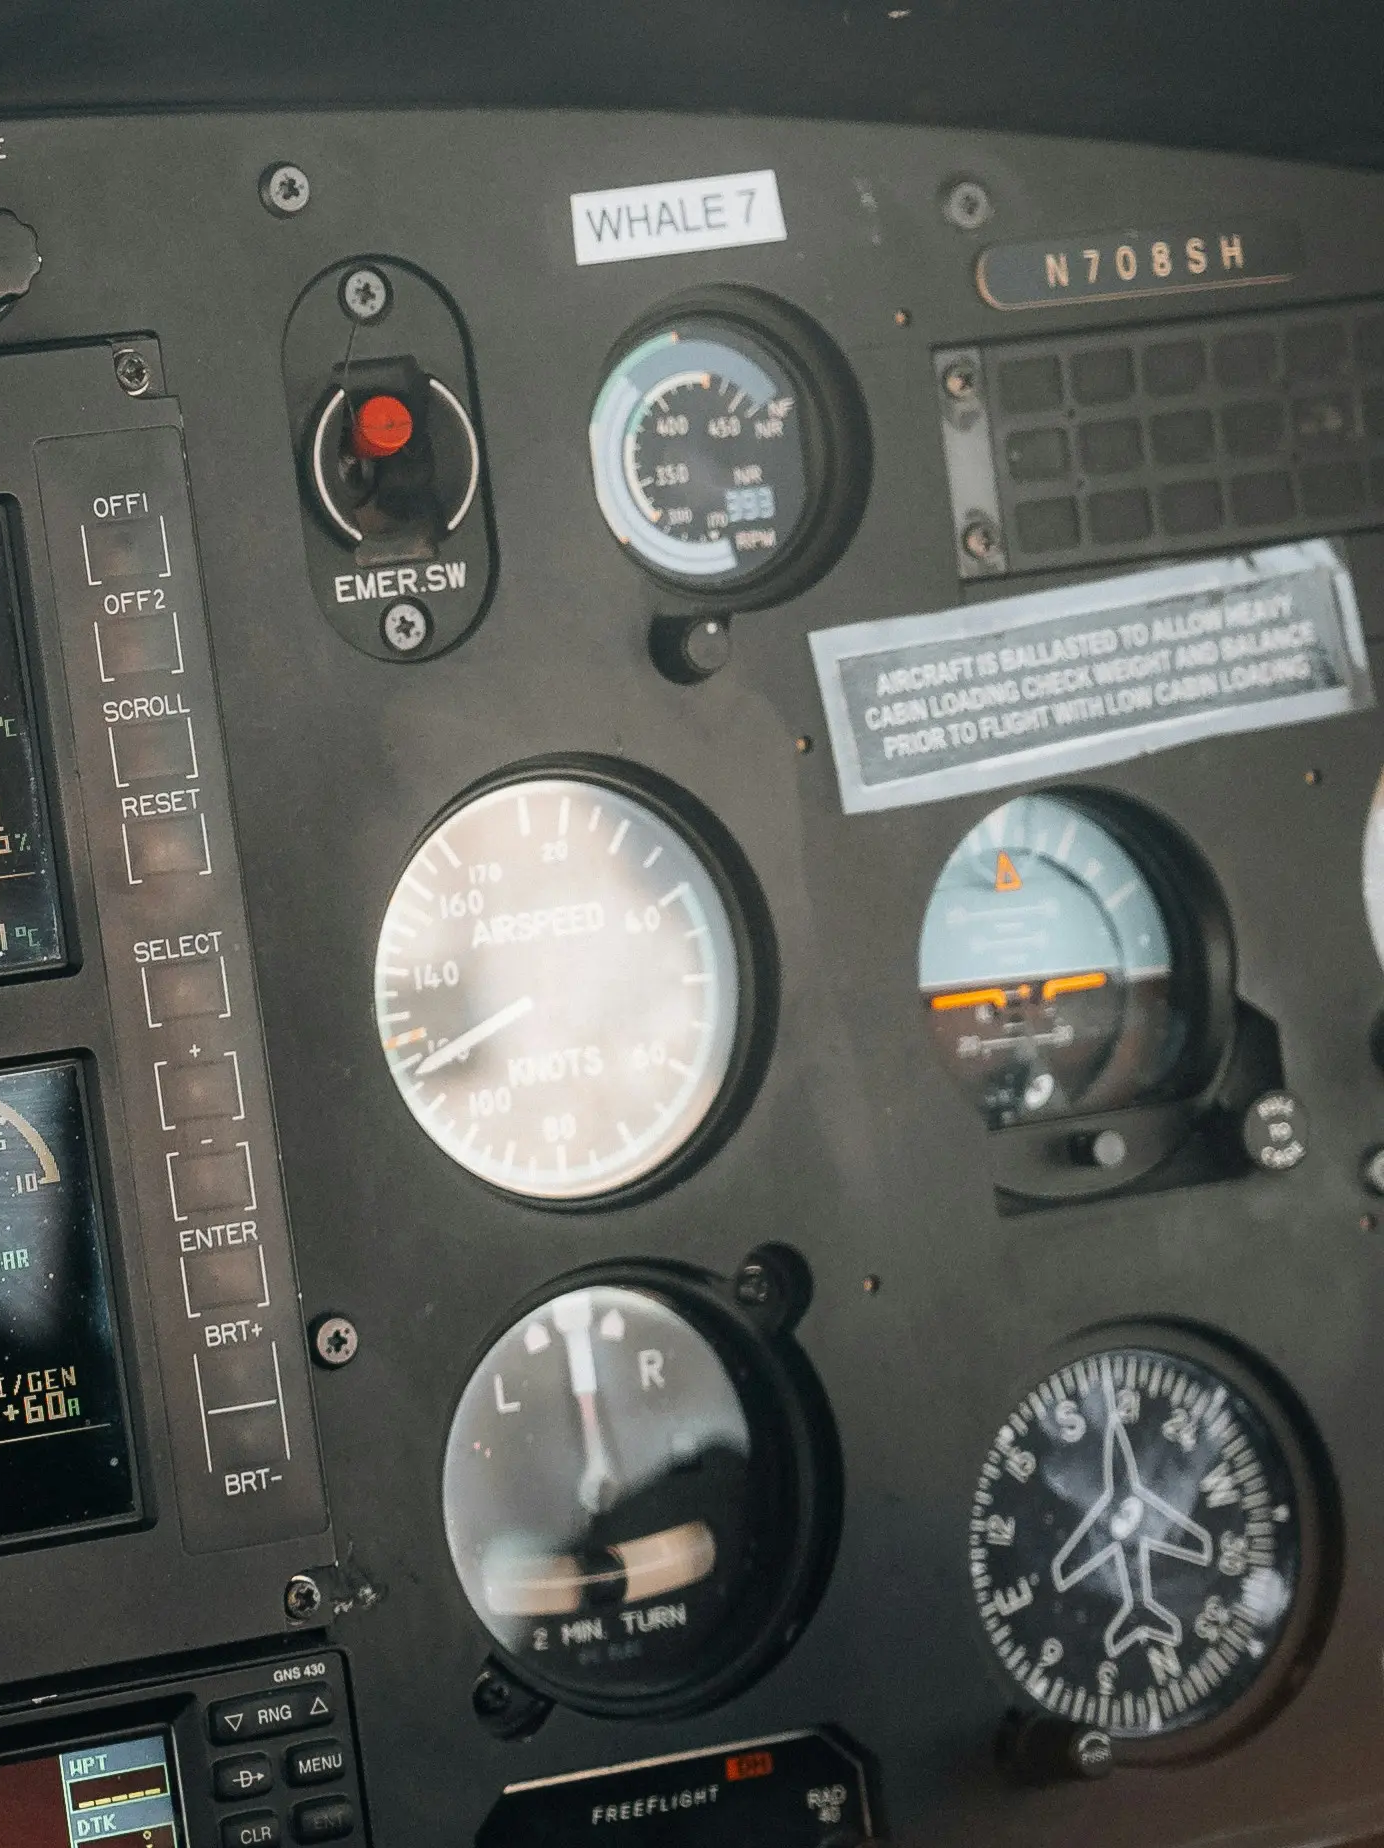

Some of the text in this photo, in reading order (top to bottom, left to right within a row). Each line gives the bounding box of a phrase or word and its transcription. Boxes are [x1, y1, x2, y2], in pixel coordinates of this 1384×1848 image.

[586, 189, 758, 242] WHALE 7
[93, 493, 148, 518] OFF1
[104, 589, 166, 615] OFF2
[103, 694, 190, 723] SCROLL
[122, 788, 200, 818] RESET
[439, 890, 484, 919] 160
[471, 902, 606, 949] AIRSPEED
[134, 930, 222, 963] SELECT
[413, 961, 460, 990] 140
[507, 1046, 603, 1089] KNOTS
[16, 1173, 38, 1194] 10
[180, 1220, 258, 1252] ENTER
[205, 1322, 262, 1348] BRT+
[638, 1349, 665, 1390] R
[495, 1373, 521, 1415] L
[1056, 1400, 1086, 1443] S
[533, 1628, 549, 1652] 2
[622, 1603, 688, 1634] TURN
[273, 1662, 325, 1683] GNS 430
[1147, 1644, 1183, 1687] N
[257, 1704, 292, 1726] RNG
[70, 1753, 108, 1777] WPT
[298, 1753, 343, 1774] MENU
[592, 1785, 720, 1825] FREEFLIGHT
[76, 1813, 116, 1836] DTK
[240, 1826, 271, 1846] CLR
